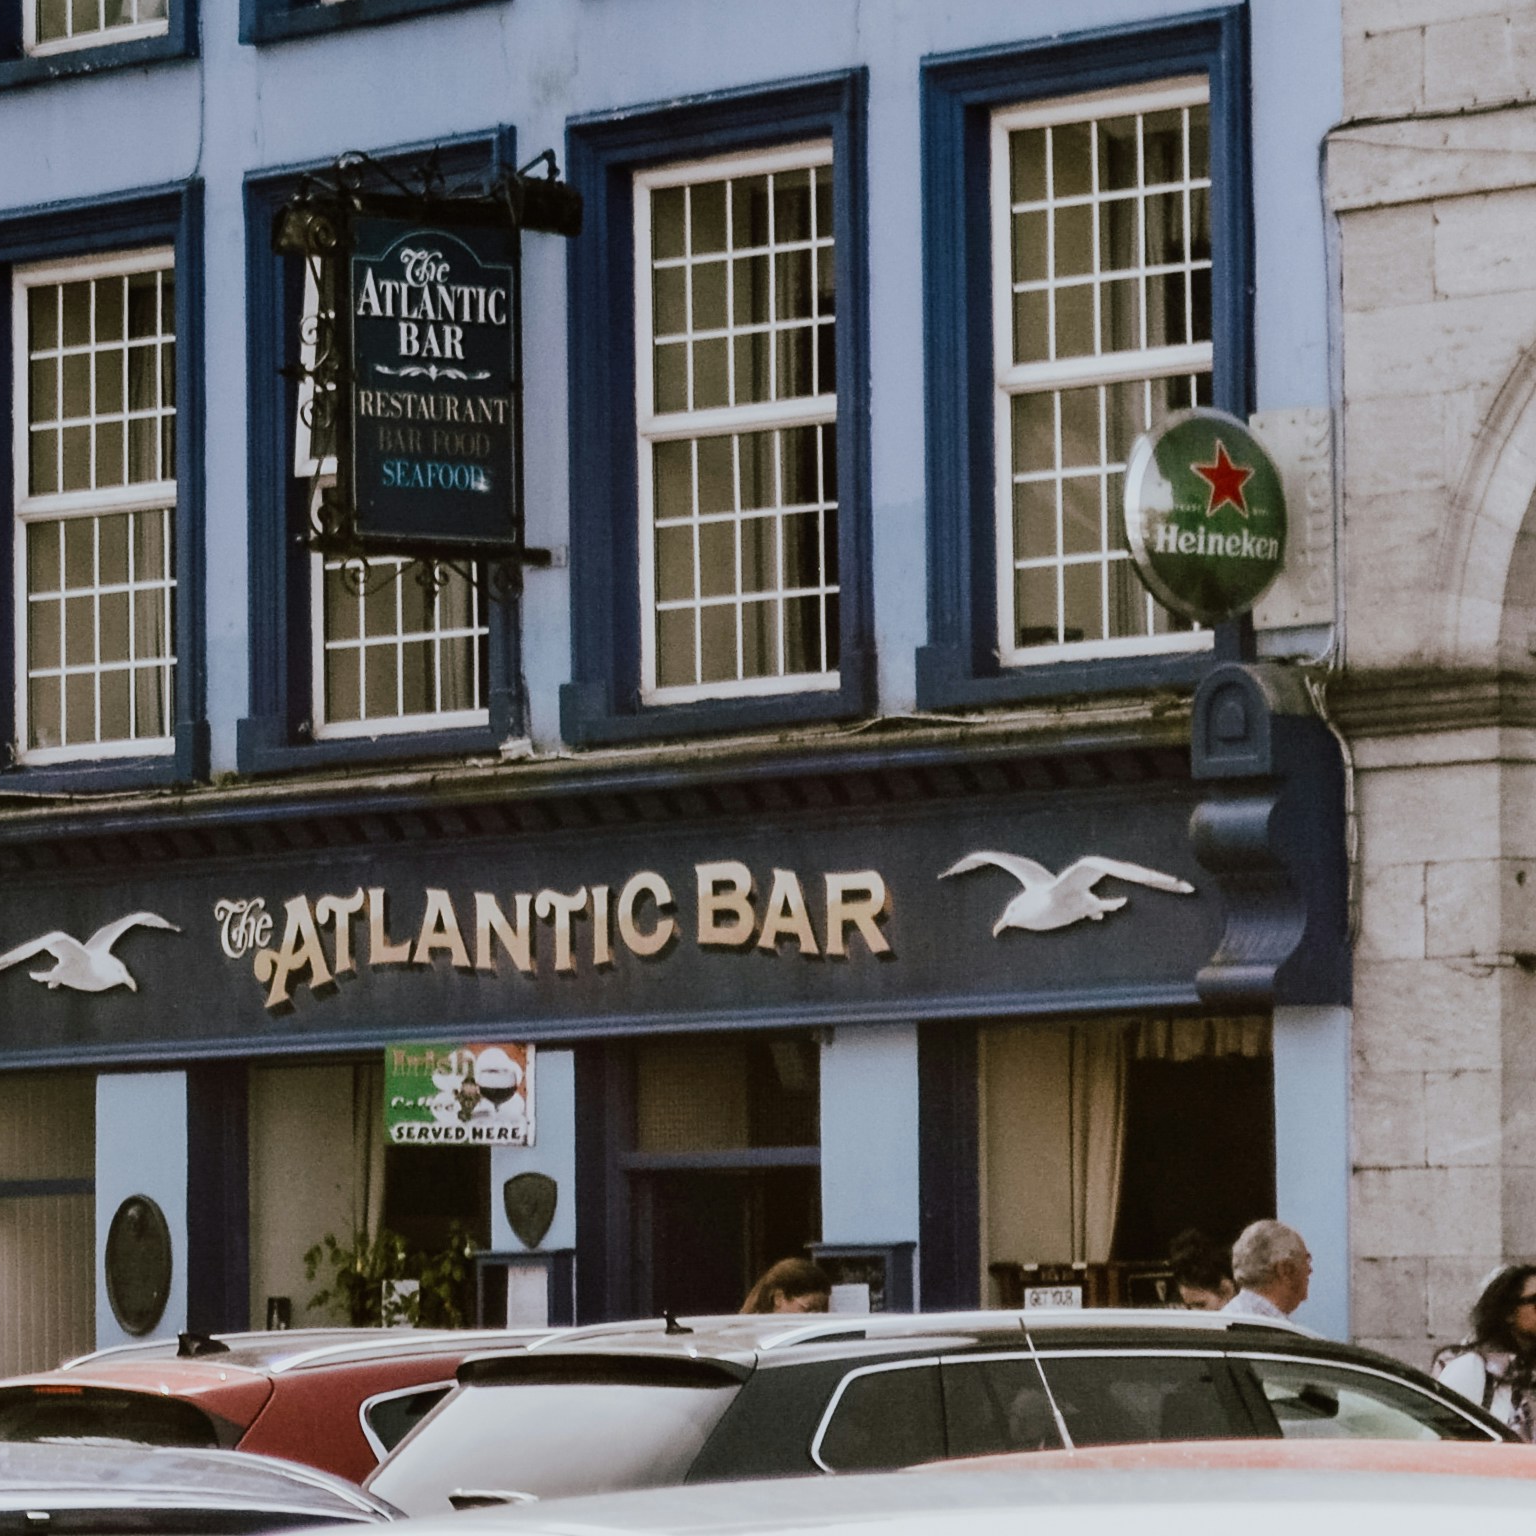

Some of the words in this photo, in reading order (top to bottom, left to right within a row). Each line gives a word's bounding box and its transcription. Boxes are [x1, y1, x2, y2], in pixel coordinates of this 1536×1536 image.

[400, 248, 450, 287] The
[356, 267, 507, 325] ATLANTIC
[398, 321, 465, 360] BAR
[359, 391, 509, 425] RESTAURANT
[378, 427, 423, 453] BAR
[432, 430, 490, 457] FOOD
[382, 460, 486, 490] SEAFOOD
[1153, 523, 1280, 560] Heineken
[215, 895, 274, 960] The
[254, 868, 677, 1011] ATLANTIC
[694, 860, 893, 958] BAR
[395, 1125, 467, 1141] SERVED
[471, 1126, 522, 1141] HERE
